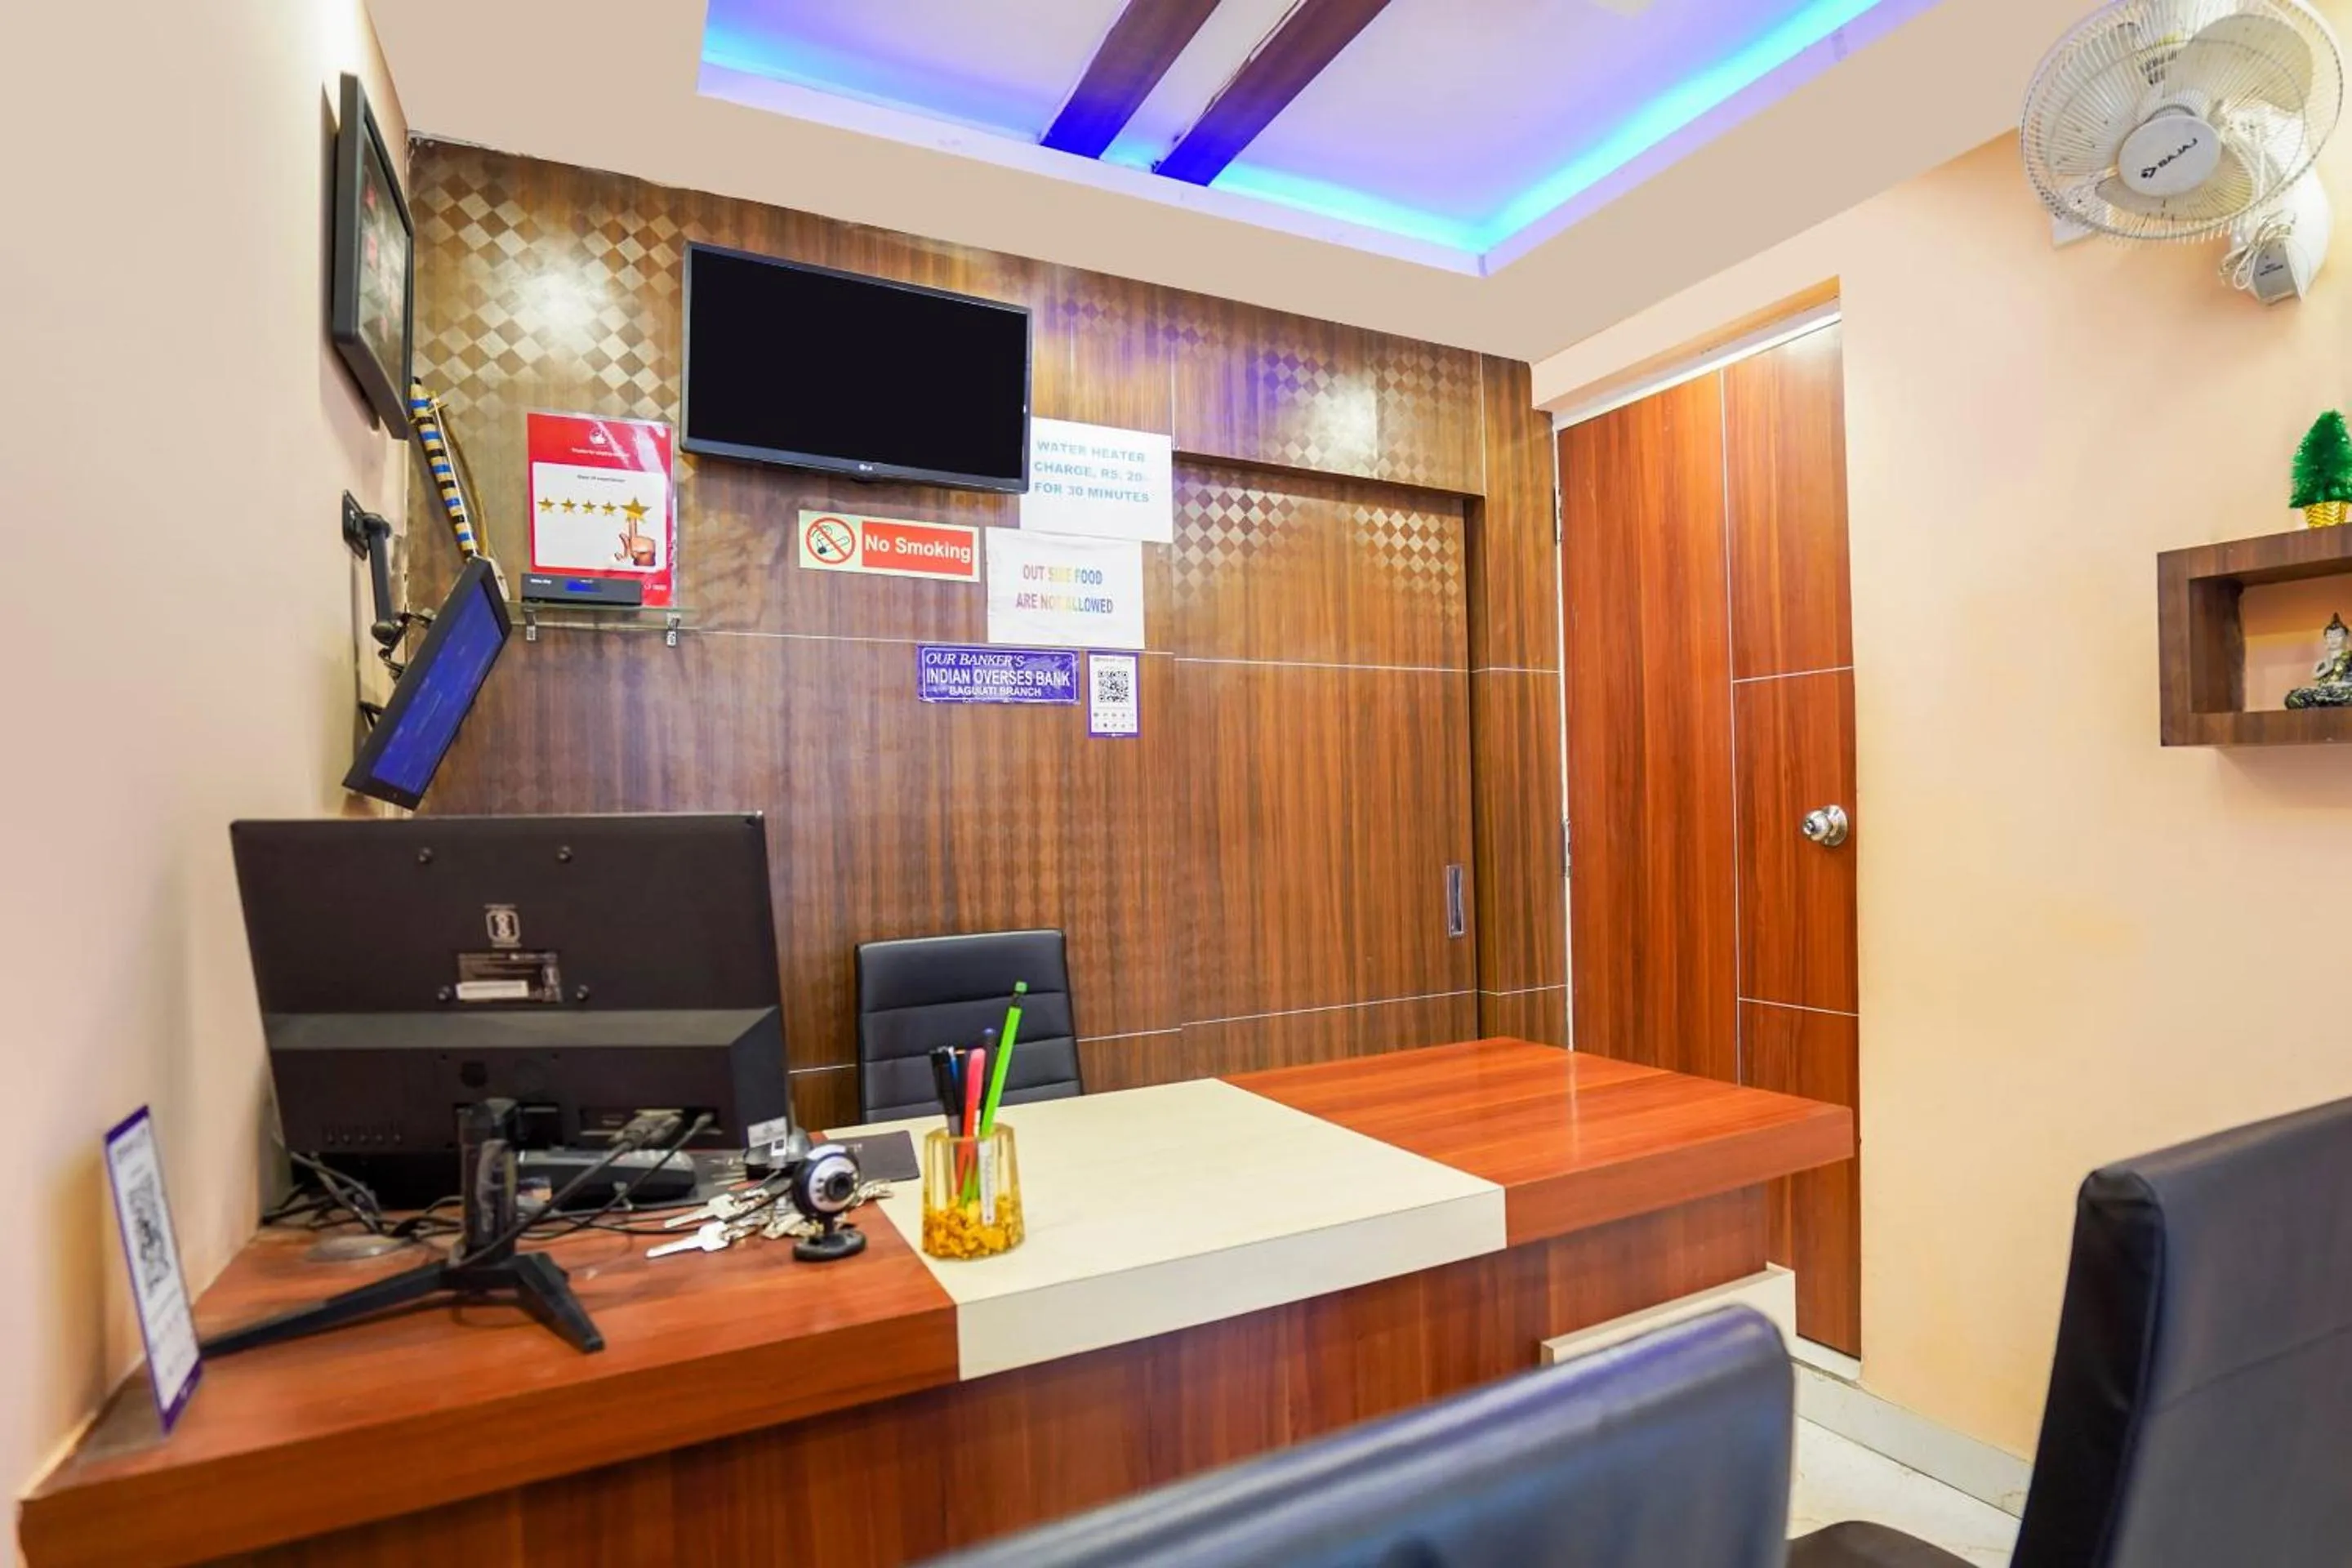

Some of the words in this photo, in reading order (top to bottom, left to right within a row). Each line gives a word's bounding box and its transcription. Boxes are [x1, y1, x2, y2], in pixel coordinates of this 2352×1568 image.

[1037, 440, 1086, 456] WATER
[1092, 448, 1145, 462] HEATER
[1034, 482, 1062, 494] FOR
[1067, 485, 1083, 496] 30
[1088, 487, 1149, 503] MINUTES
[865, 534, 890, 552] No
[895, 537, 971, 564] Smoking
[1023, 564, 1045, 581] OUT
[1075, 568, 1102, 585] FOOD
[1016, 593, 1037, 609] ARE
[1065, 596, 1114, 613] ALLOWED
[926, 653, 956, 665] OUR
[959, 653, 1025, 670] BANKER'S
[926, 668, 970, 684] INDIAN
[973, 669, 1033, 686] OVERSES
[1036, 671, 1071, 687] BANK
[1000, 686, 1042, 697] BRANCH
